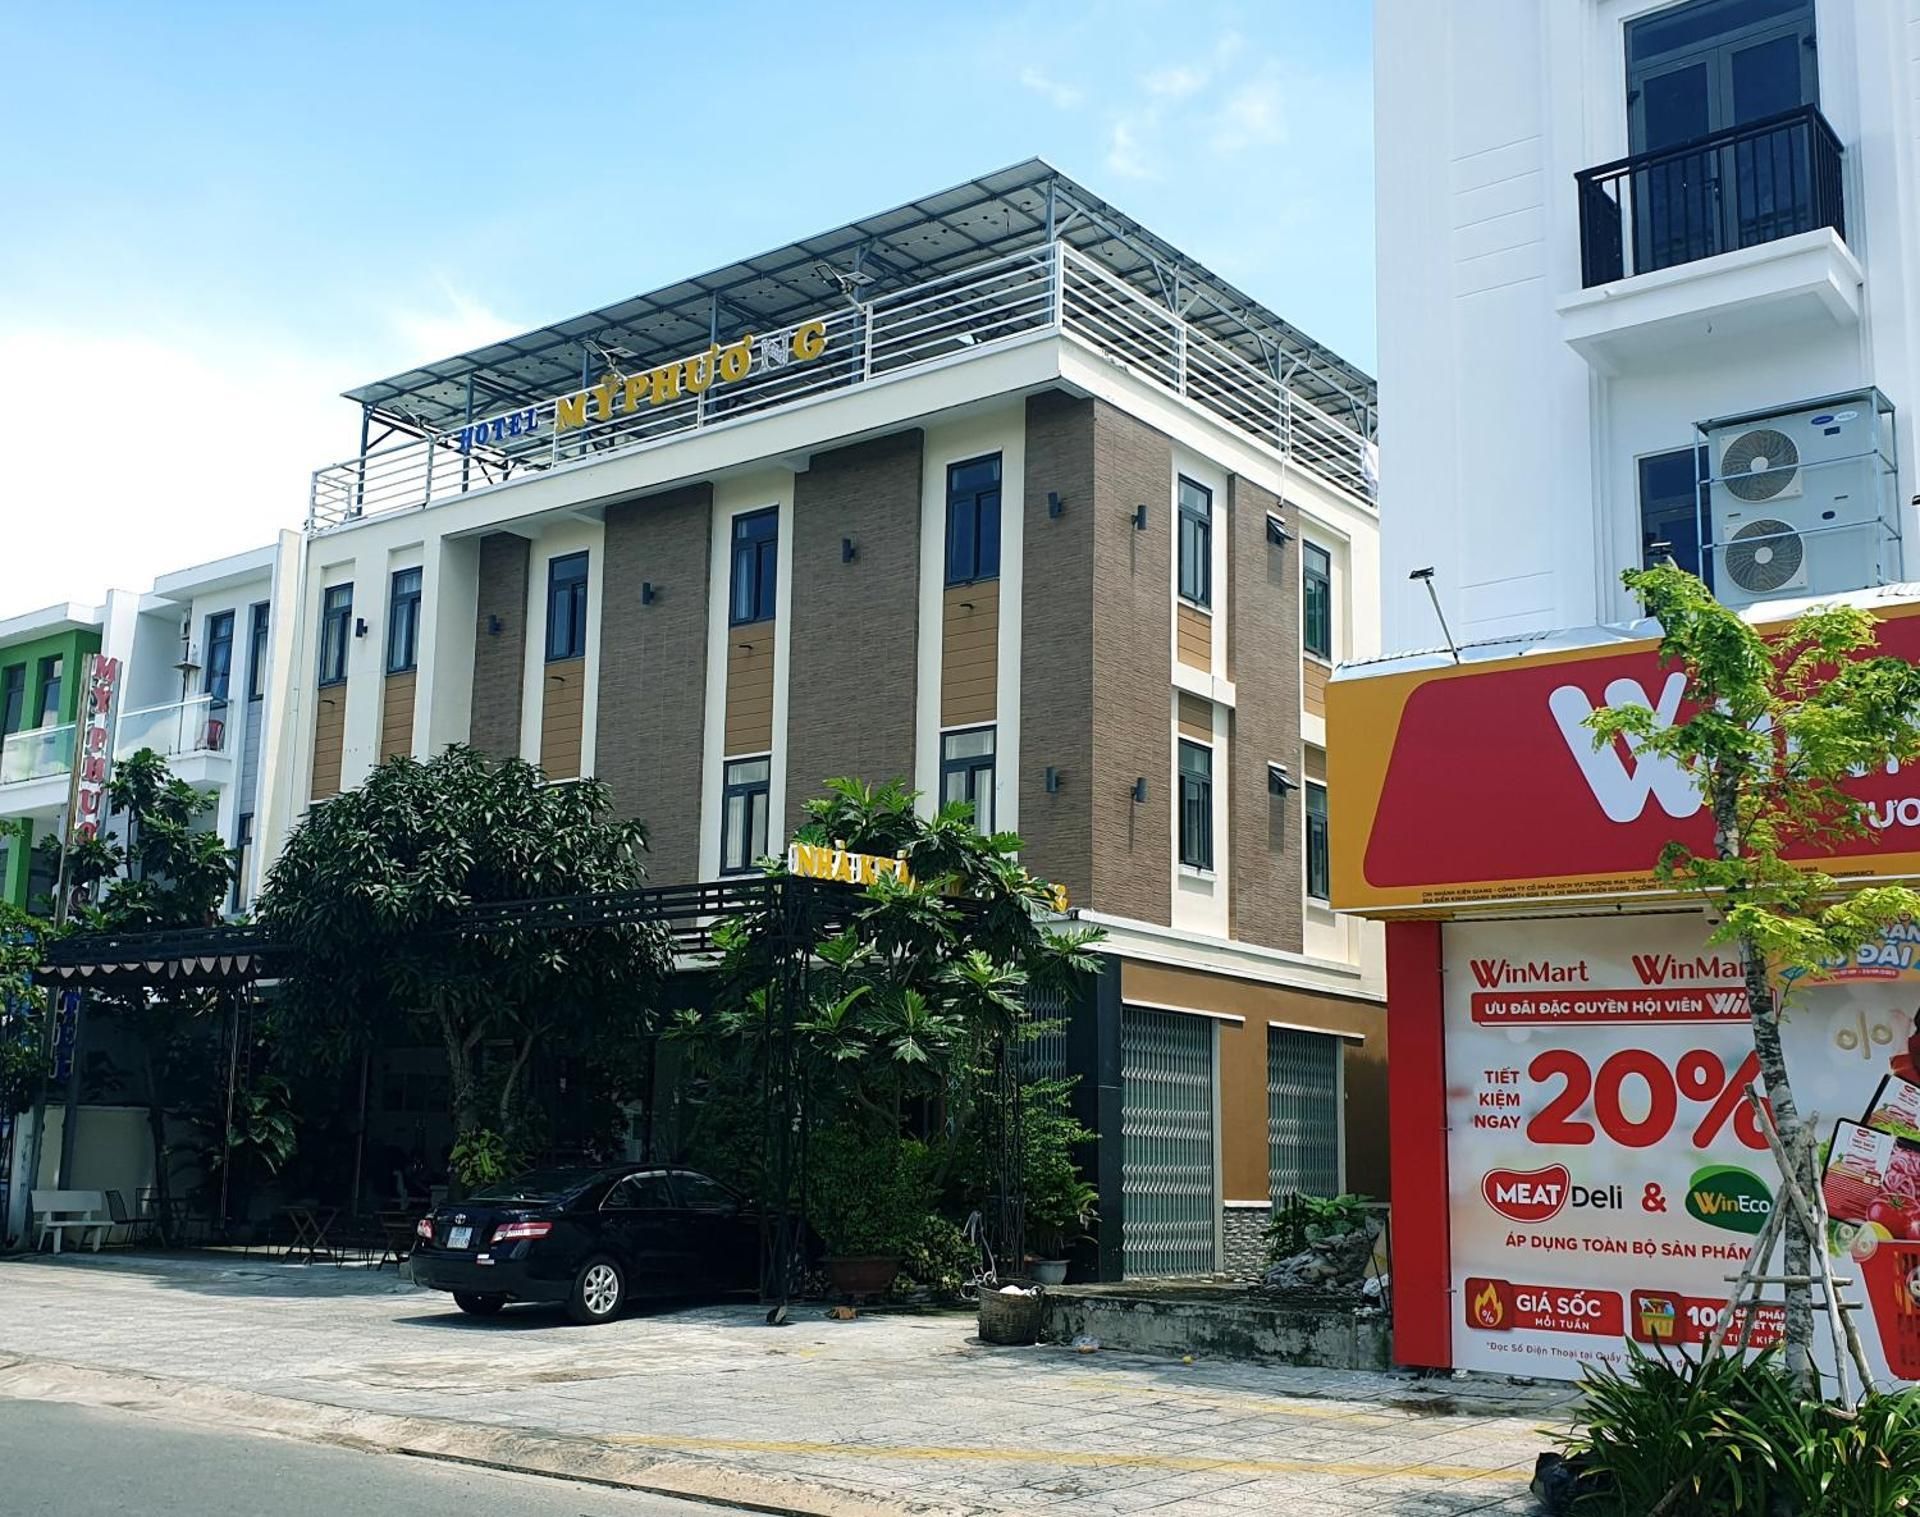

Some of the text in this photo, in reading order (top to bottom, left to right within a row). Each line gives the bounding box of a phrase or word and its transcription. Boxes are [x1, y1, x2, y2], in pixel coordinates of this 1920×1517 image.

[460, 408, 540, 451] HOTEL
[1470, 958, 1590, 988] WinMart
[1485, 1001, 1506, 1015] ƯU
[1510, 1000, 1536, 1015] ĐÃI
[1539, 999, 1570, 1018] ĐẶC
[1574, 997, 1628, 1015] QUYỀN
[1632, 997, 1661, 1016] HỘI
[1664, 996, 1702, 1013] VIÊN
[1484, 1065, 1520, 1084] TIẾT
[1479, 1089, 1521, 1110] KIỆM
[1526, 1048, 1778, 1150] 20%
[1474, 1114, 1521, 1129] NGAY
[1641, 1182, 1667, 1213] &
[1692, 1190, 1771, 1216] WinEco
[1505, 1231, 1526, 1247] ÁP
[1531, 1234, 1578, 1253] DỤNG
[1582, 1236, 1628, 1254] TOÀN
[1633, 1239, 1657, 1259] BỘ
[1662, 1238, 1697, 1258] SẢN
[1516, 1290, 1602, 1317] GIÁ SỐC
[1511, 1342, 1523, 1353] Số
[1526, 1344, 1548, 1357] Điện
